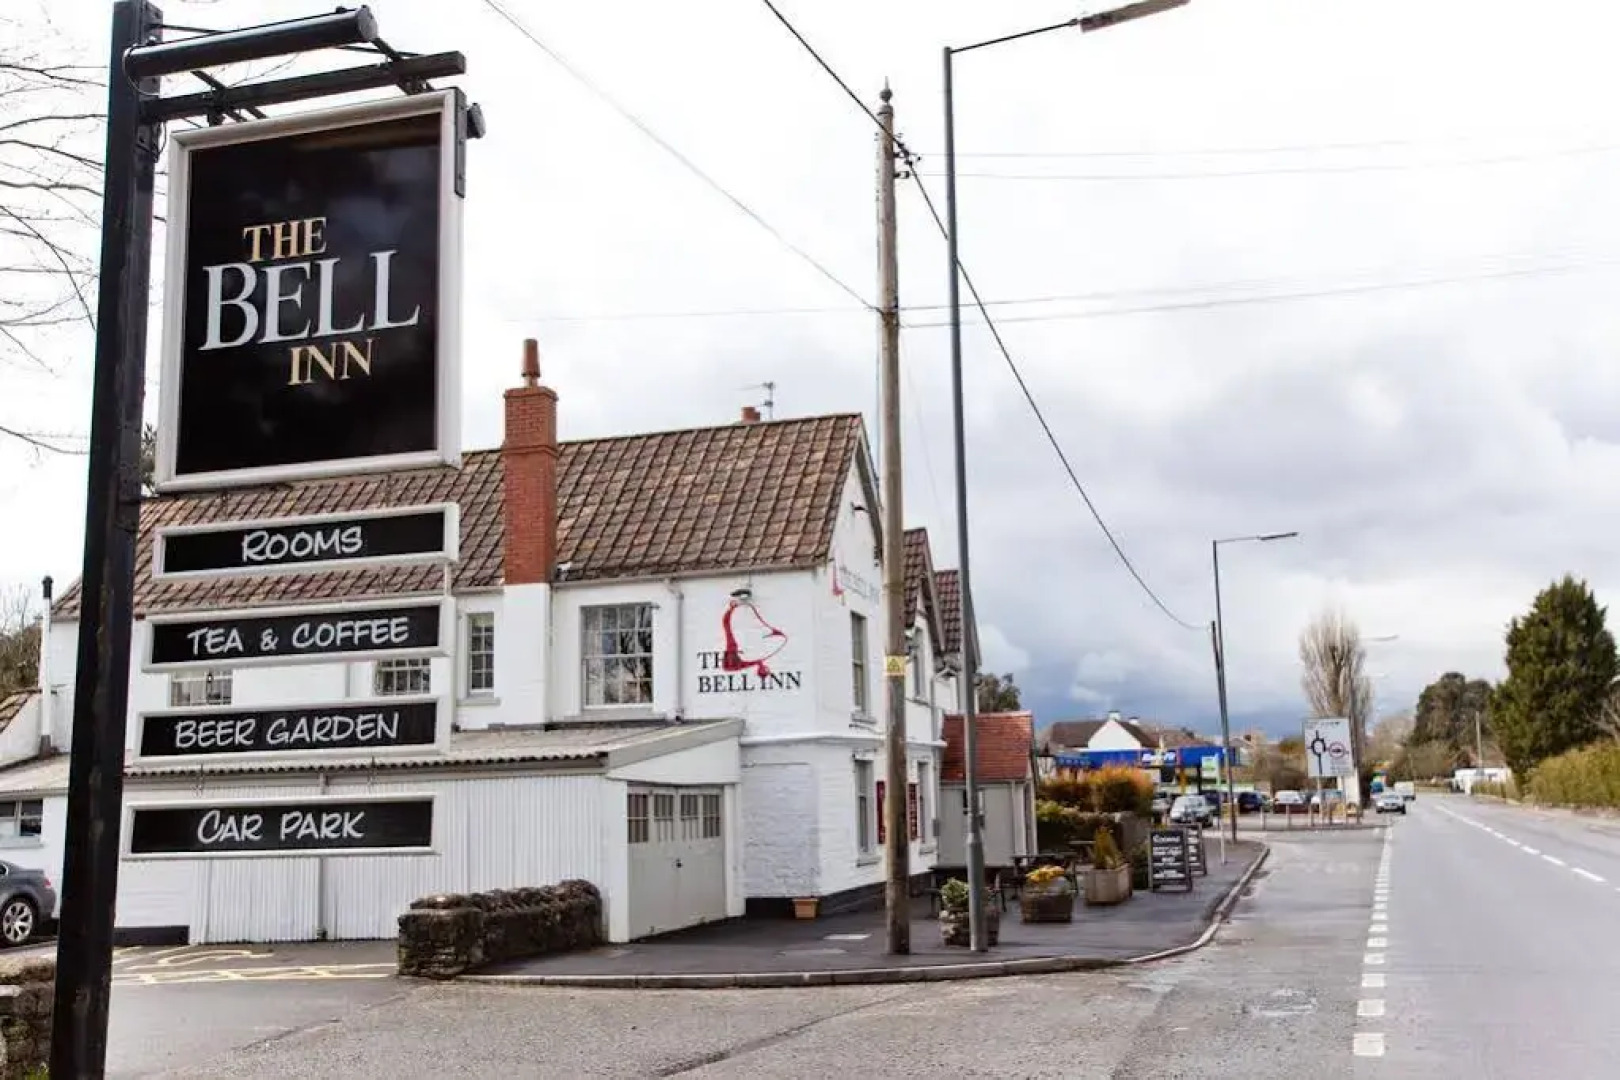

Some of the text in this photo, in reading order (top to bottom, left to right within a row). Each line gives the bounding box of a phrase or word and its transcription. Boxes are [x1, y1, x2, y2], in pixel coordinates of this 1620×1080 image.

[243, 217, 327, 263] THE
[198, 250, 420, 351] BELL
[288, 339, 373, 386] INN
[241, 526, 363, 562] ROOMS
[187, 617, 410, 655] TEA & COFFEE
[698, 670, 801, 693] BELL INN
[175, 712, 399, 748] BEER GARDEN
[197, 810, 365, 844] CAR PARK
